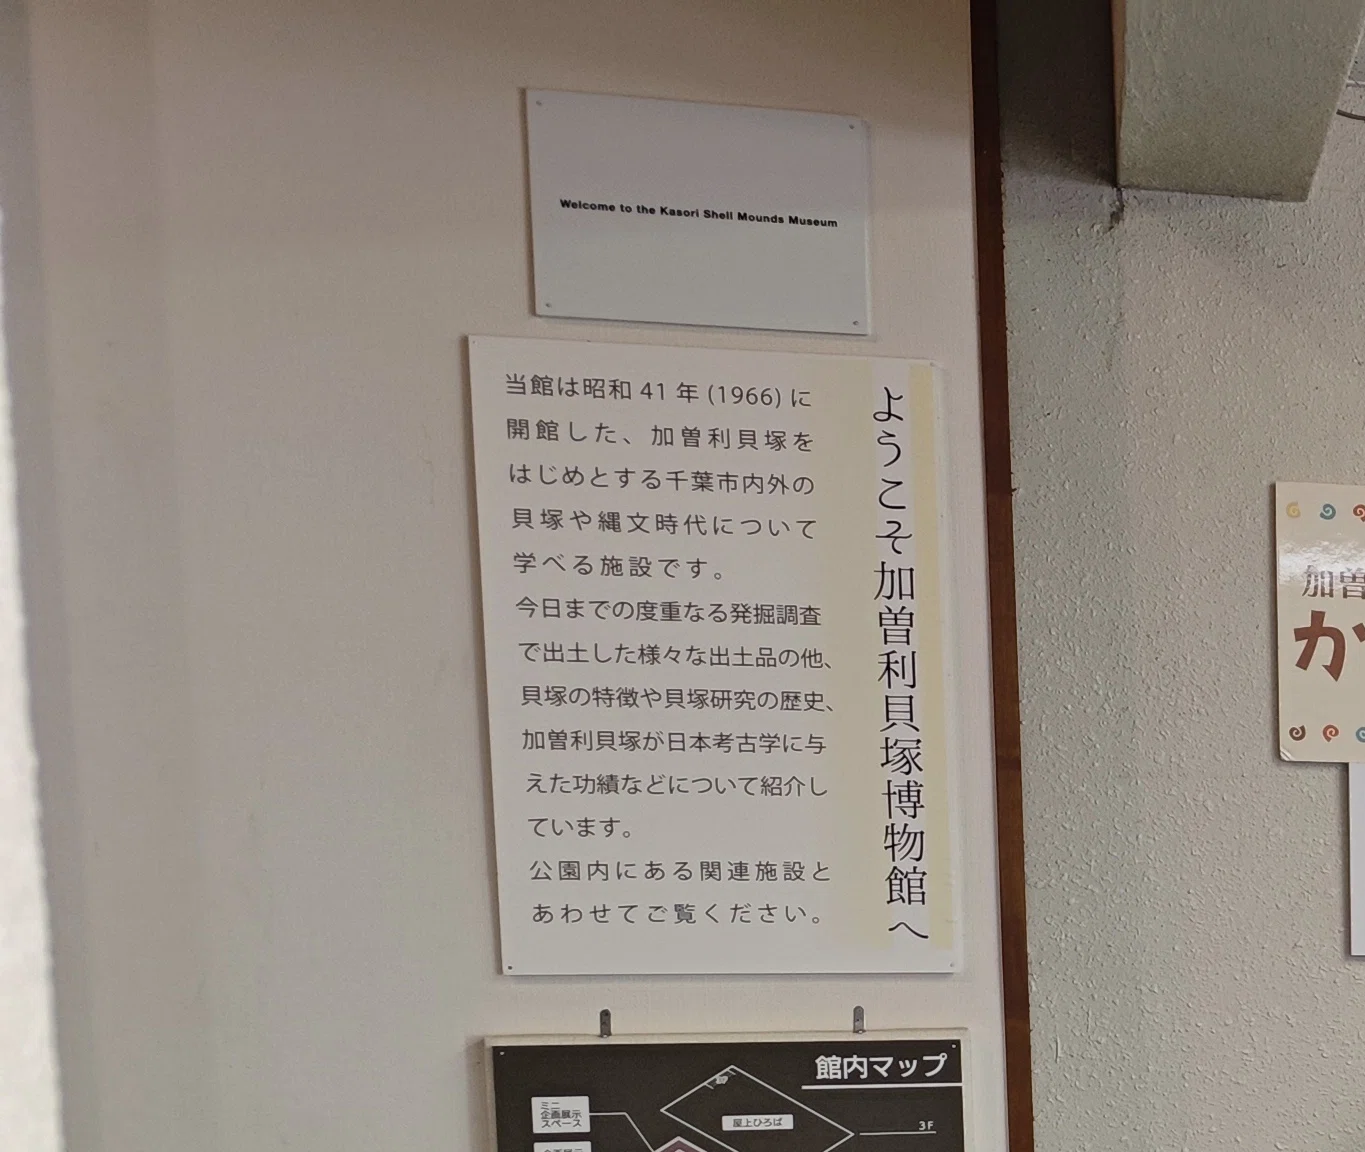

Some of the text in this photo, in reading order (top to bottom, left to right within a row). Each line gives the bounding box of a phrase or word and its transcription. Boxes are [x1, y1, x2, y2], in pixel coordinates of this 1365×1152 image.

[559, 198, 838, 227] Welcome to the Kasori Shell Mounds Museum
[505, 372, 811, 409] 当館は昭和 41 年 (1966) に
[506, 417, 813, 452] 開館した、加曽利貝塚を
[509, 463, 814, 495] はじめとする千葉市内外の
[511, 507, 816, 539] 貝塚や縄文時代について
[513, 551, 721, 580] 学べる施設です。
[515, 595, 821, 626] 今日までの度重なる発掘調査
[518, 640, 831, 669] で出土した様々な出土品の他、
[873, 386, 929, 940] ようこそ加曽利貝塚博物館へ
[520, 684, 833, 712] 貝塚の特徴や貝塚研究の歴史、
[521, 728, 826, 754] 加曽利貝塚が日本考古学に与
[525, 772, 827, 797] えた功績などについて紹介し
[527, 816, 630, 838] ています。
[529, 859, 830, 881] 公園内にある関連施設と
[532, 902, 819, 924] あわせてご覧ください。
[814, 1052, 947, 1081] 館内マップ
[540, 1109, 582, 1119] 企画展示
[540, 1118, 582, 1128] スペース
[732, 1116, 782, 1128] 屋上ひろば
[918, 1120, 933, 1130] 3F
